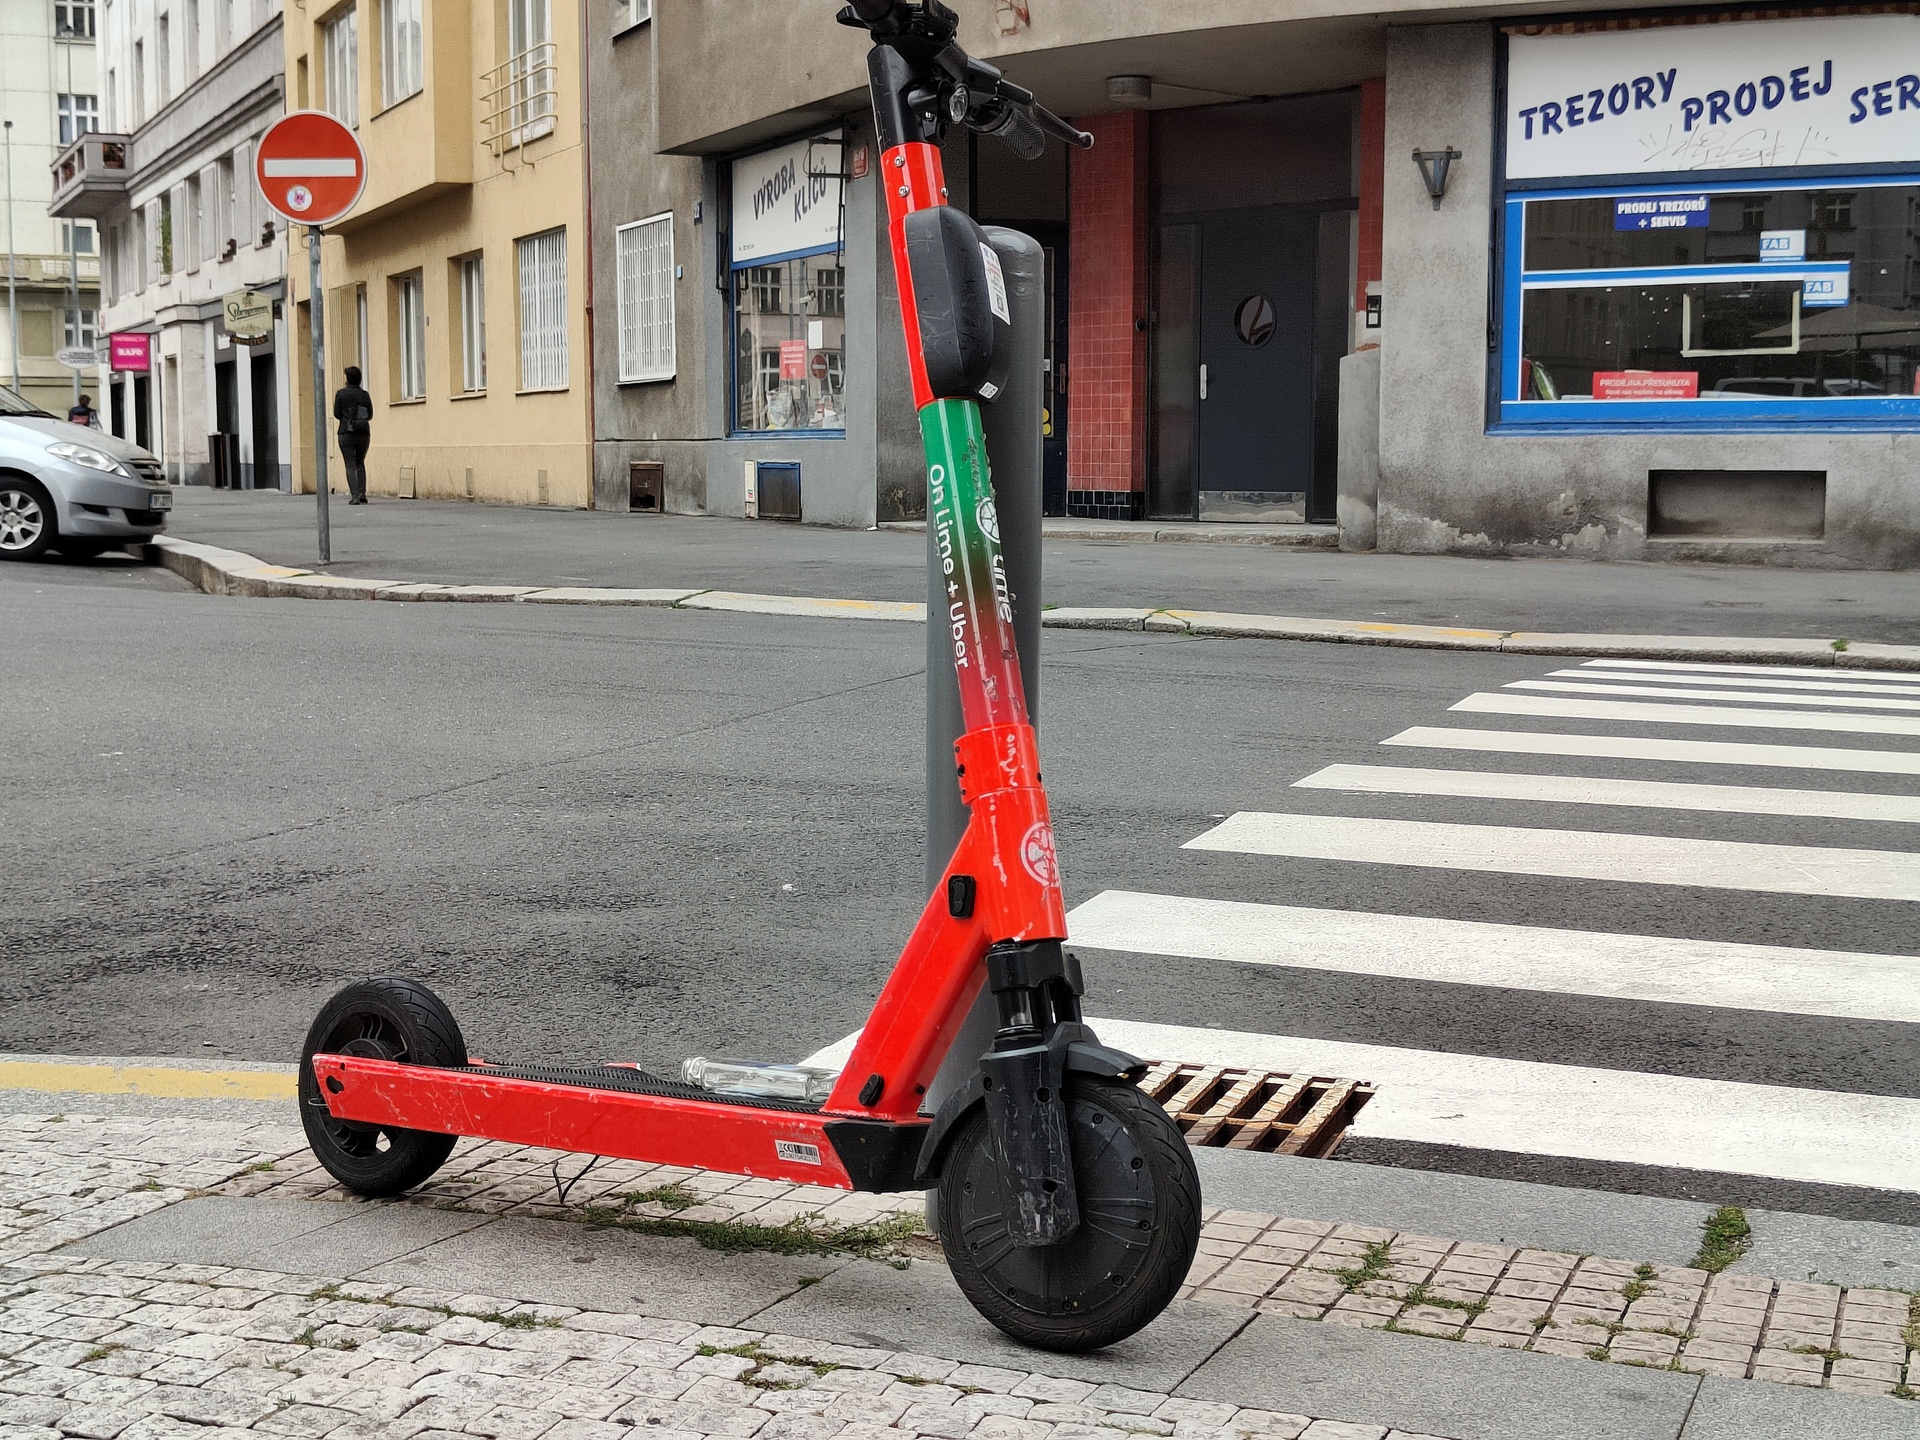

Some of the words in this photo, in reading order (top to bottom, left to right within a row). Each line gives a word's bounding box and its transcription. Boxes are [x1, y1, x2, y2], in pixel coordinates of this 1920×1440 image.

[1518, 67, 1678, 141] TREZORY
[1680, 59, 1833, 133] PRODEJ
[1849, 74, 1920, 124] SER
[753, 157, 796, 221] VÝROBA
[1617, 201, 1658, 215] PRODEJ
[1650, 214, 1688, 228] SERVIS
[1762, 238, 1789, 251] FAB
[1805, 281, 1833, 295] FAB
[929, 463, 945, 506] On
[935, 507, 955, 576] Lime
[949, 601, 969, 669] Uber
